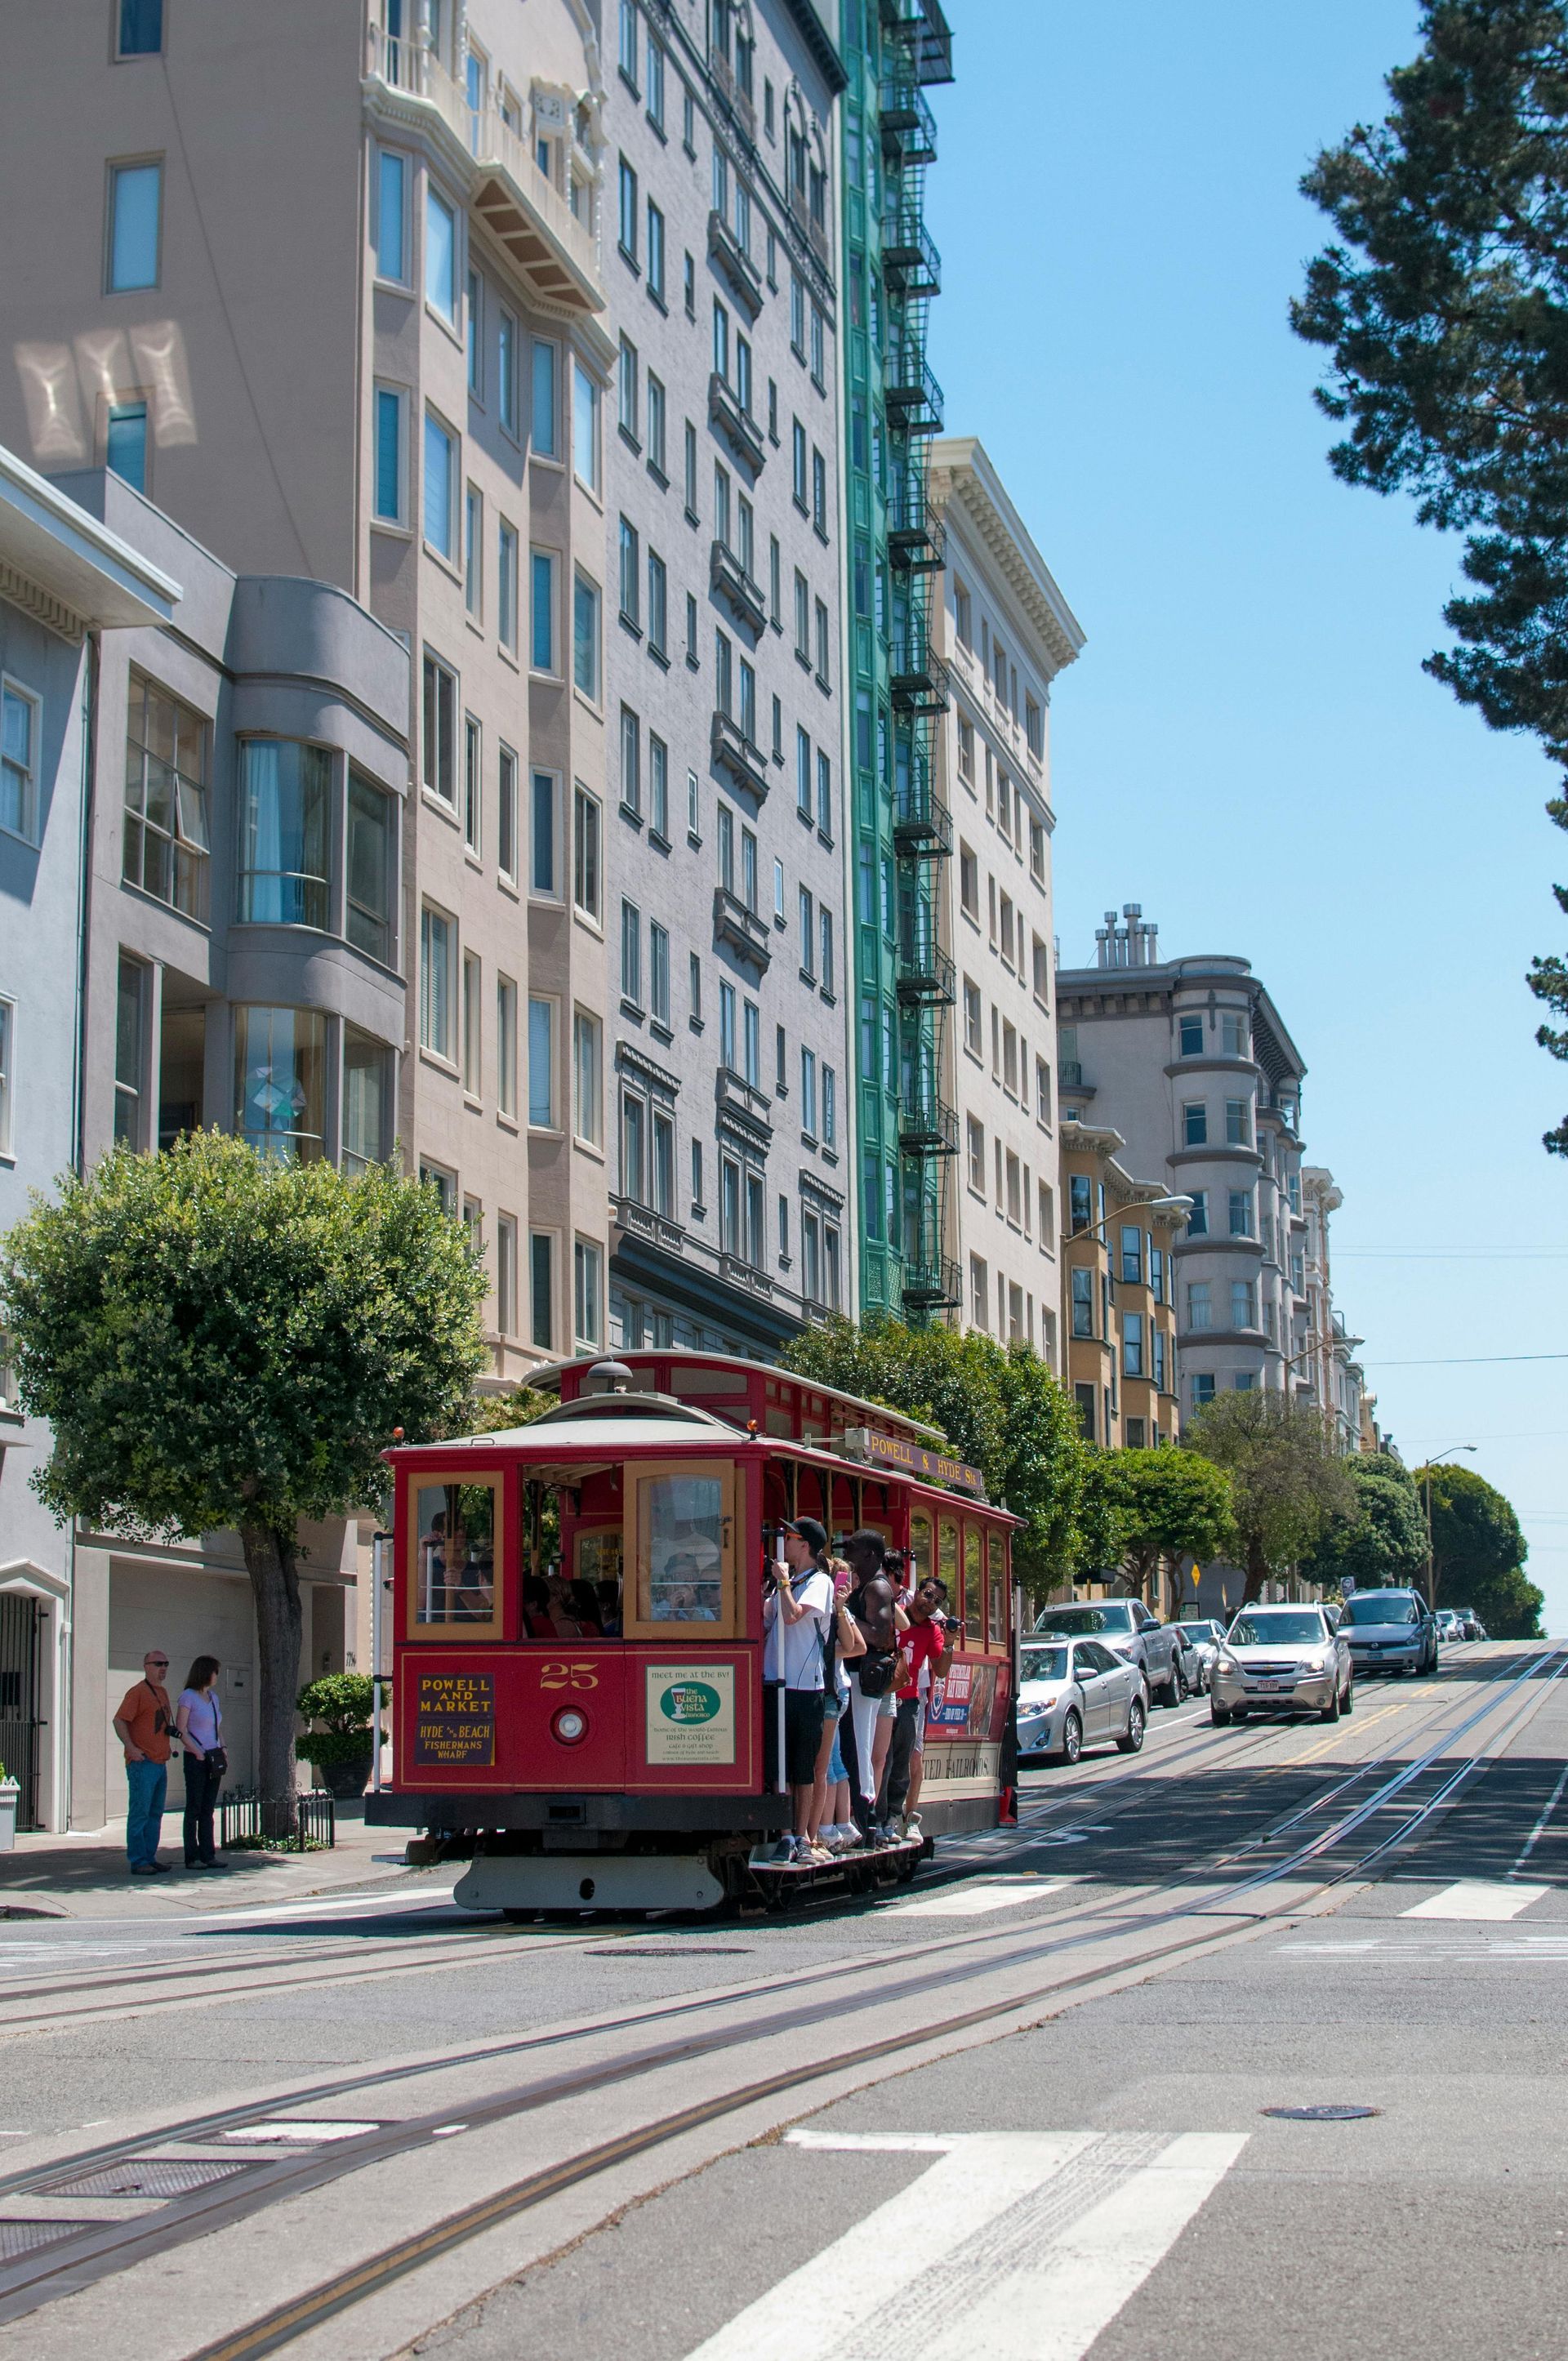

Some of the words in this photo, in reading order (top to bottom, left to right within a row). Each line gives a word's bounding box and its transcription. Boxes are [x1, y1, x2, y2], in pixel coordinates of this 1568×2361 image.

[871, 1436, 914, 1464] POWELL
[922, 1454, 929, 1470] &
[938, 1459, 961, 1481] HYDE
[541, 1663, 599, 1690] 25
[421, 1679, 490, 1691] POWELL
[439, 1691, 473, 1700] AND
[421, 1701, 491, 1712] MARKET
[420, 1725, 444, 1738] HYDE
[458, 1725, 490, 1738] BEACH
[425, 1740, 483, 1749] FISHERMANS
[438, 1750, 467, 1759] WHARF
